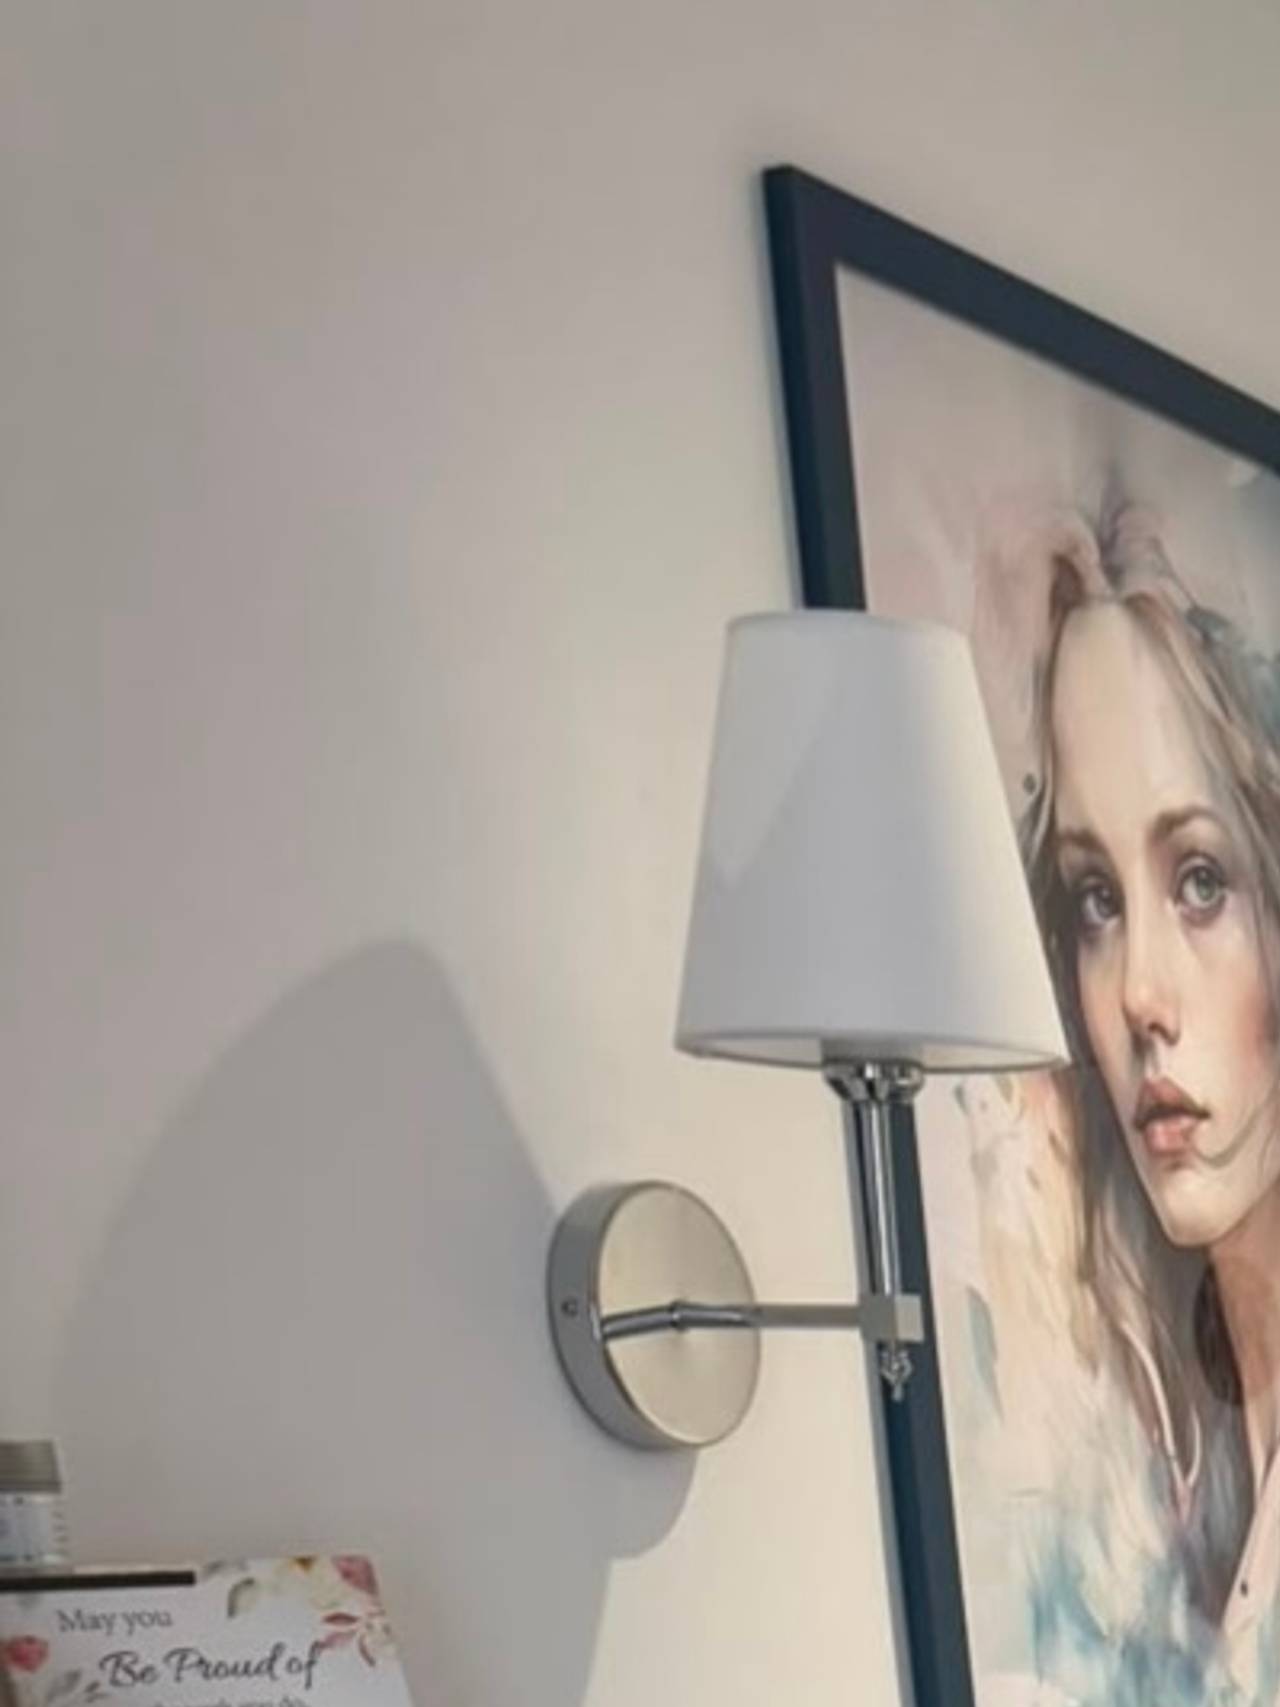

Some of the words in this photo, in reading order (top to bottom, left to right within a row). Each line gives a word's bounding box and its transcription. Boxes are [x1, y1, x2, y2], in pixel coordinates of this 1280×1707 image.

[56, 1609, 118, 1636] May
[123, 1610, 173, 1636] you
[99, 1650, 159, 1687] Be
[163, 1641, 287, 1683] Proud
[286, 1641, 322, 1690] of
